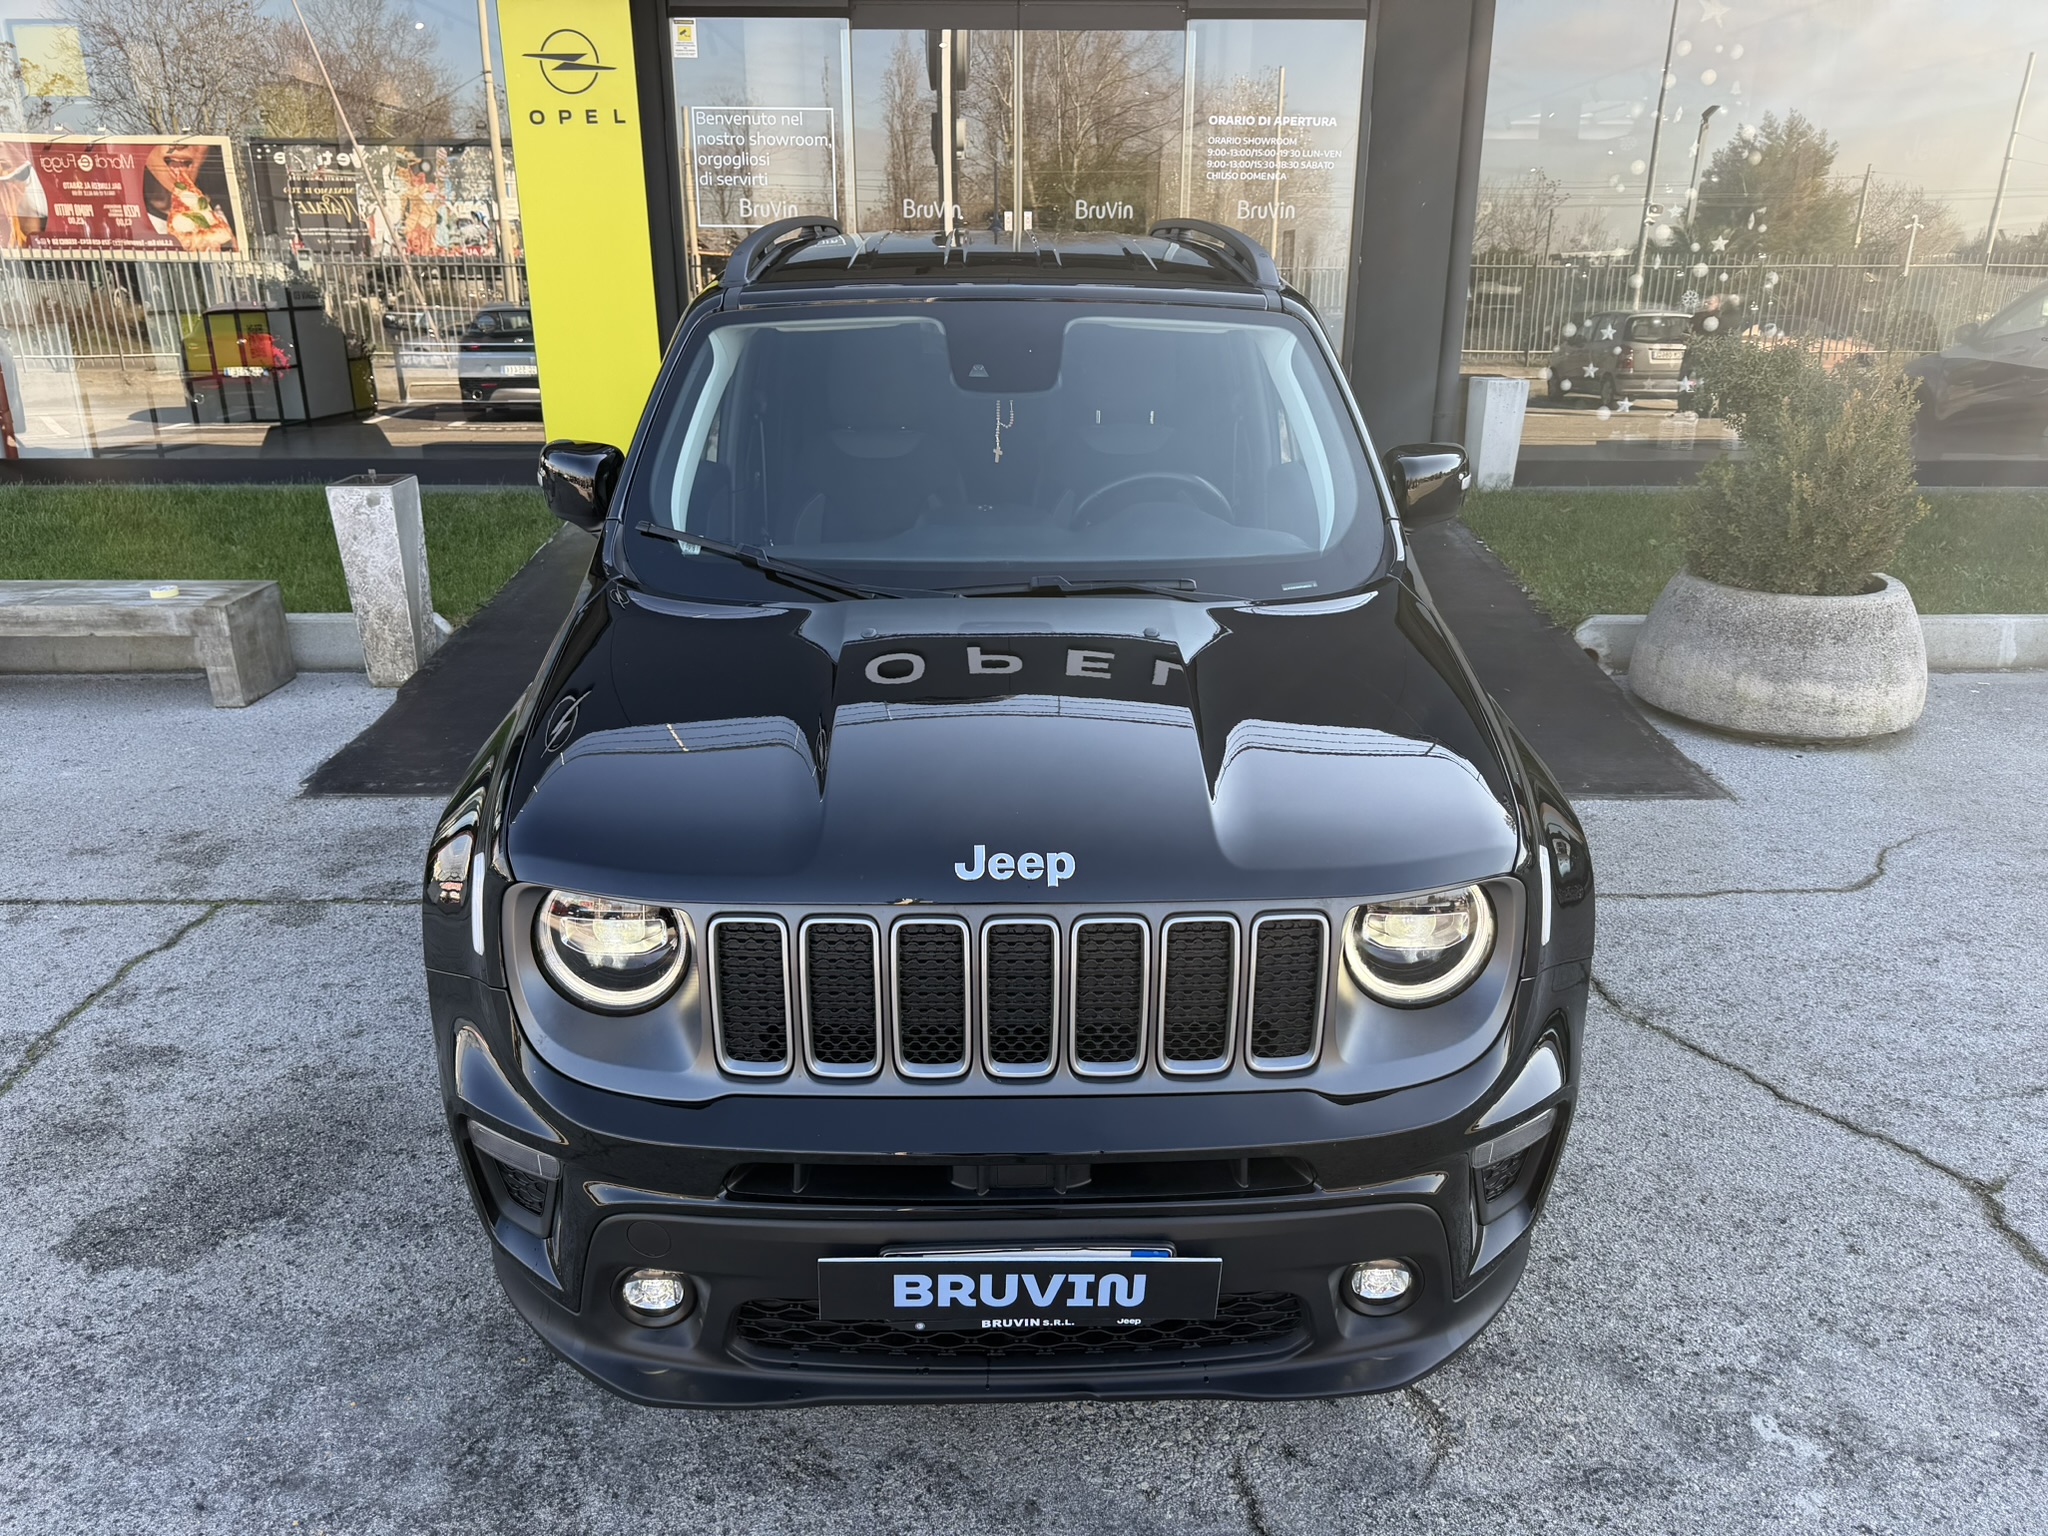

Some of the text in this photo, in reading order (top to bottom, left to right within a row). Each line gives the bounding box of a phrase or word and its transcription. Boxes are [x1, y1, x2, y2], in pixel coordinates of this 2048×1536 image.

[528, 108, 626, 125] OPEL
[695, 111, 803, 126] Benvenuto nel
[1208, 115, 1338, 127] ORARIO DI APERTURA
[696, 132, 833, 148] nostro showroom,
[1207, 136, 1298, 146] ORARIO SHOWROOM
[697, 152, 771, 170] orgogliosi
[1302, 149, 1343, 158] LUN-VEN
[1300, 160, 1335, 170] SABATO
[699, 172, 768, 186] di servirti
[1206, 171, 1239, 181] CHIUSO
[739, 198, 799, 219] BruVin
[902, 198, 962, 219] BruVn
[1074, 199, 1134, 220] BruVin
[1236, 199, 1296, 220] BruVin
[954, 844, 1077, 888] Jeep
[893, 1273, 1147, 1308] BRUVIN
[981, 1317, 1075, 1329] BRUVIN S.R.L.
[1116, 1317, 1142, 1326] Jeep
